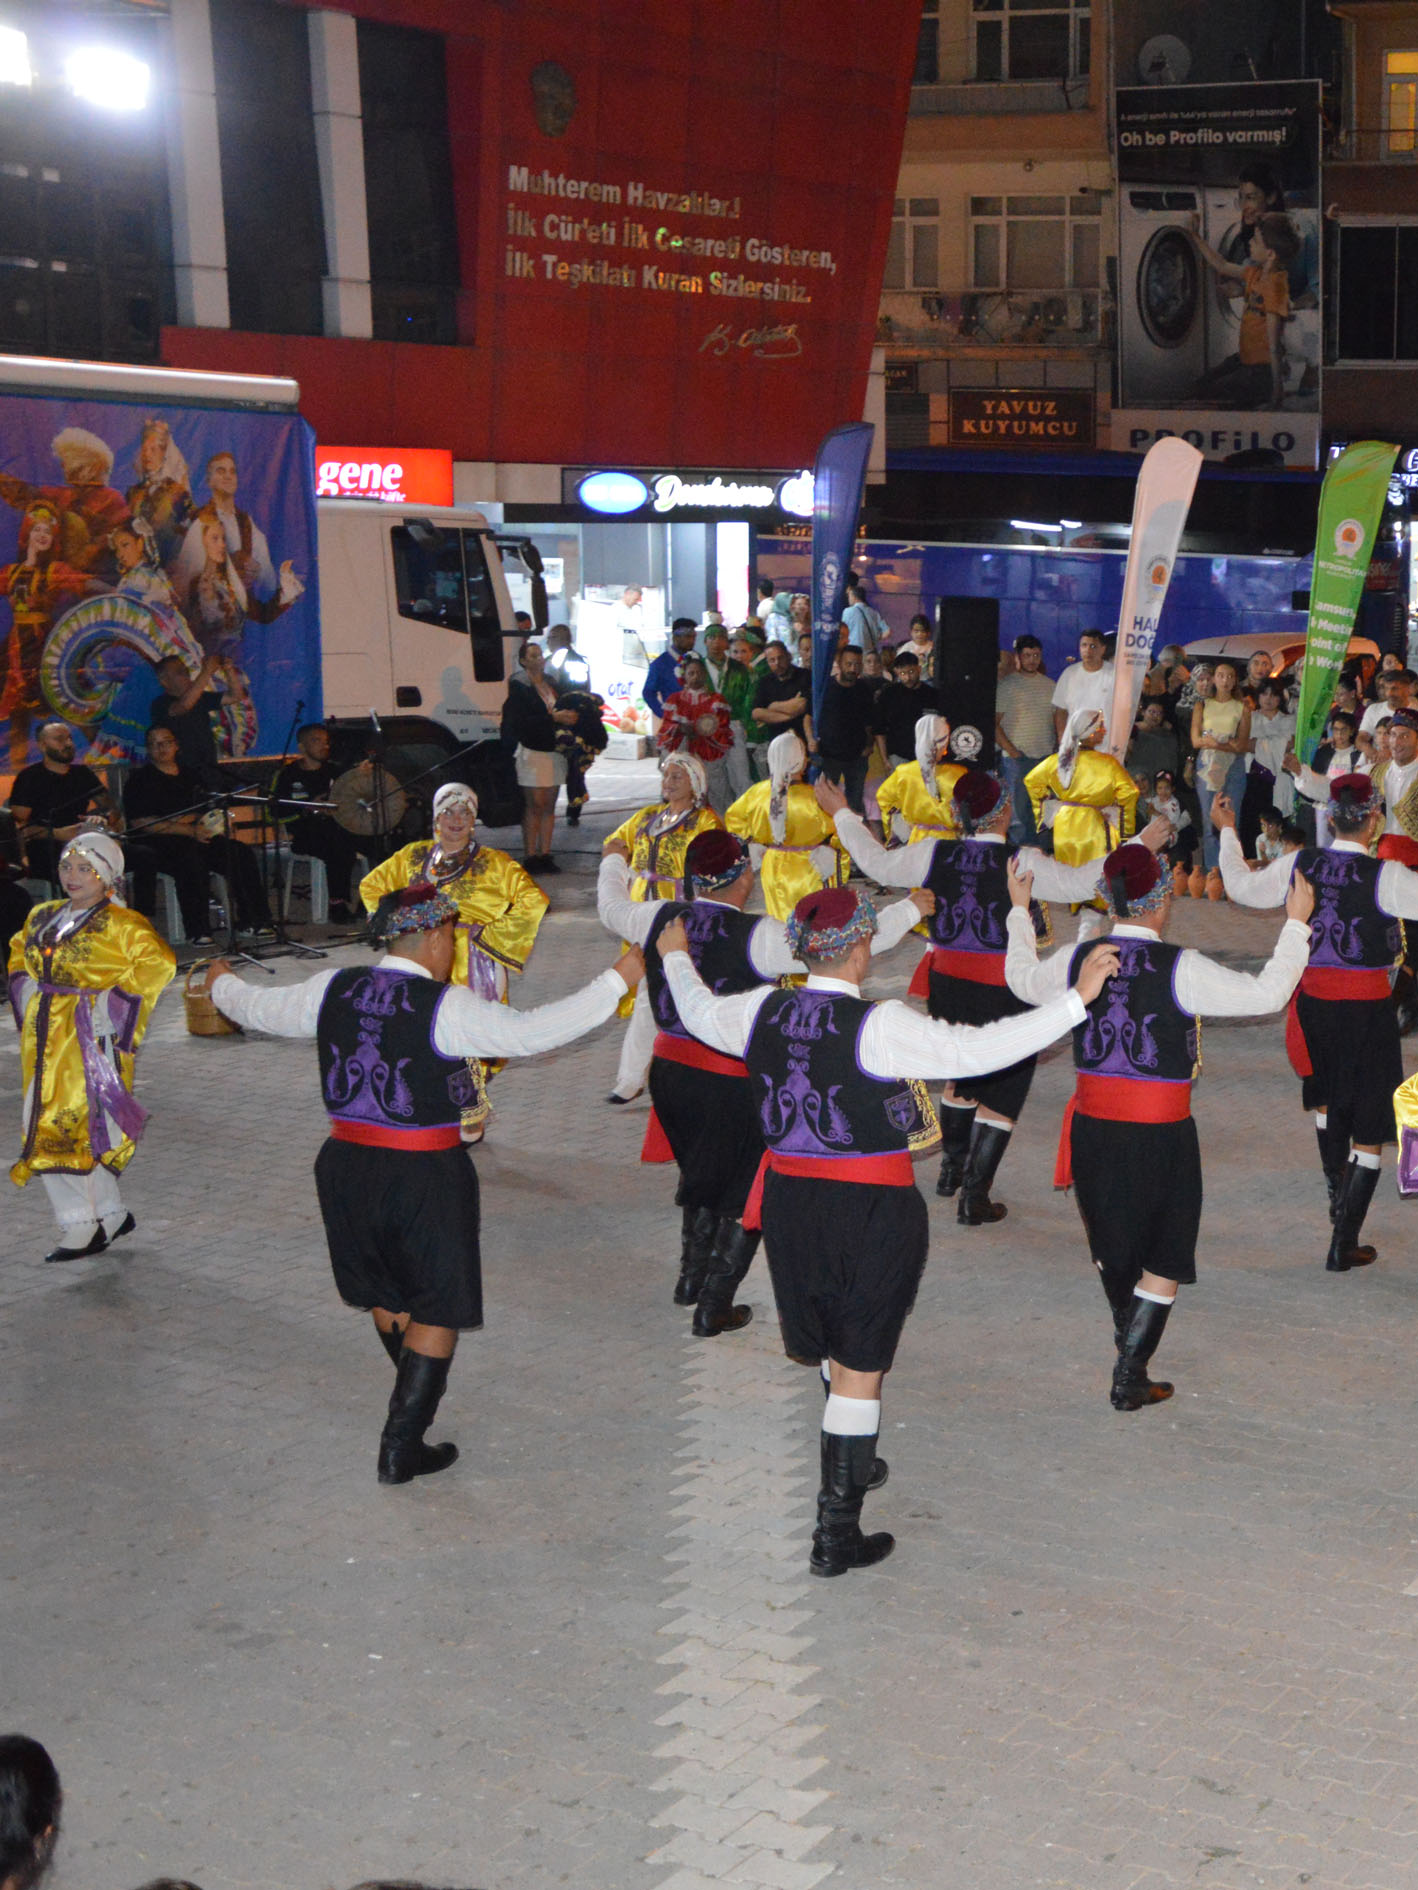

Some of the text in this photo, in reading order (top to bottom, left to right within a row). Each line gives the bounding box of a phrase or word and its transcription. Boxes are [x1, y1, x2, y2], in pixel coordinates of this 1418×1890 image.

[1120, 126, 1287, 147] Oh be Profilo varmış!
[508, 165, 621, 204] Muhterem
[543, 213, 617, 246] Cür'eti
[655, 226, 741, 260] Cesareti
[745, 237, 837, 276] Gösteren,
[541, 253, 636, 288] Teşkilatı
[642, 264, 703, 294] Kuran
[709, 271, 812, 304] Sizlersiniz.
[982, 400, 1058, 416] YAVUZ
[962, 419, 1079, 436] KUYUMCU
